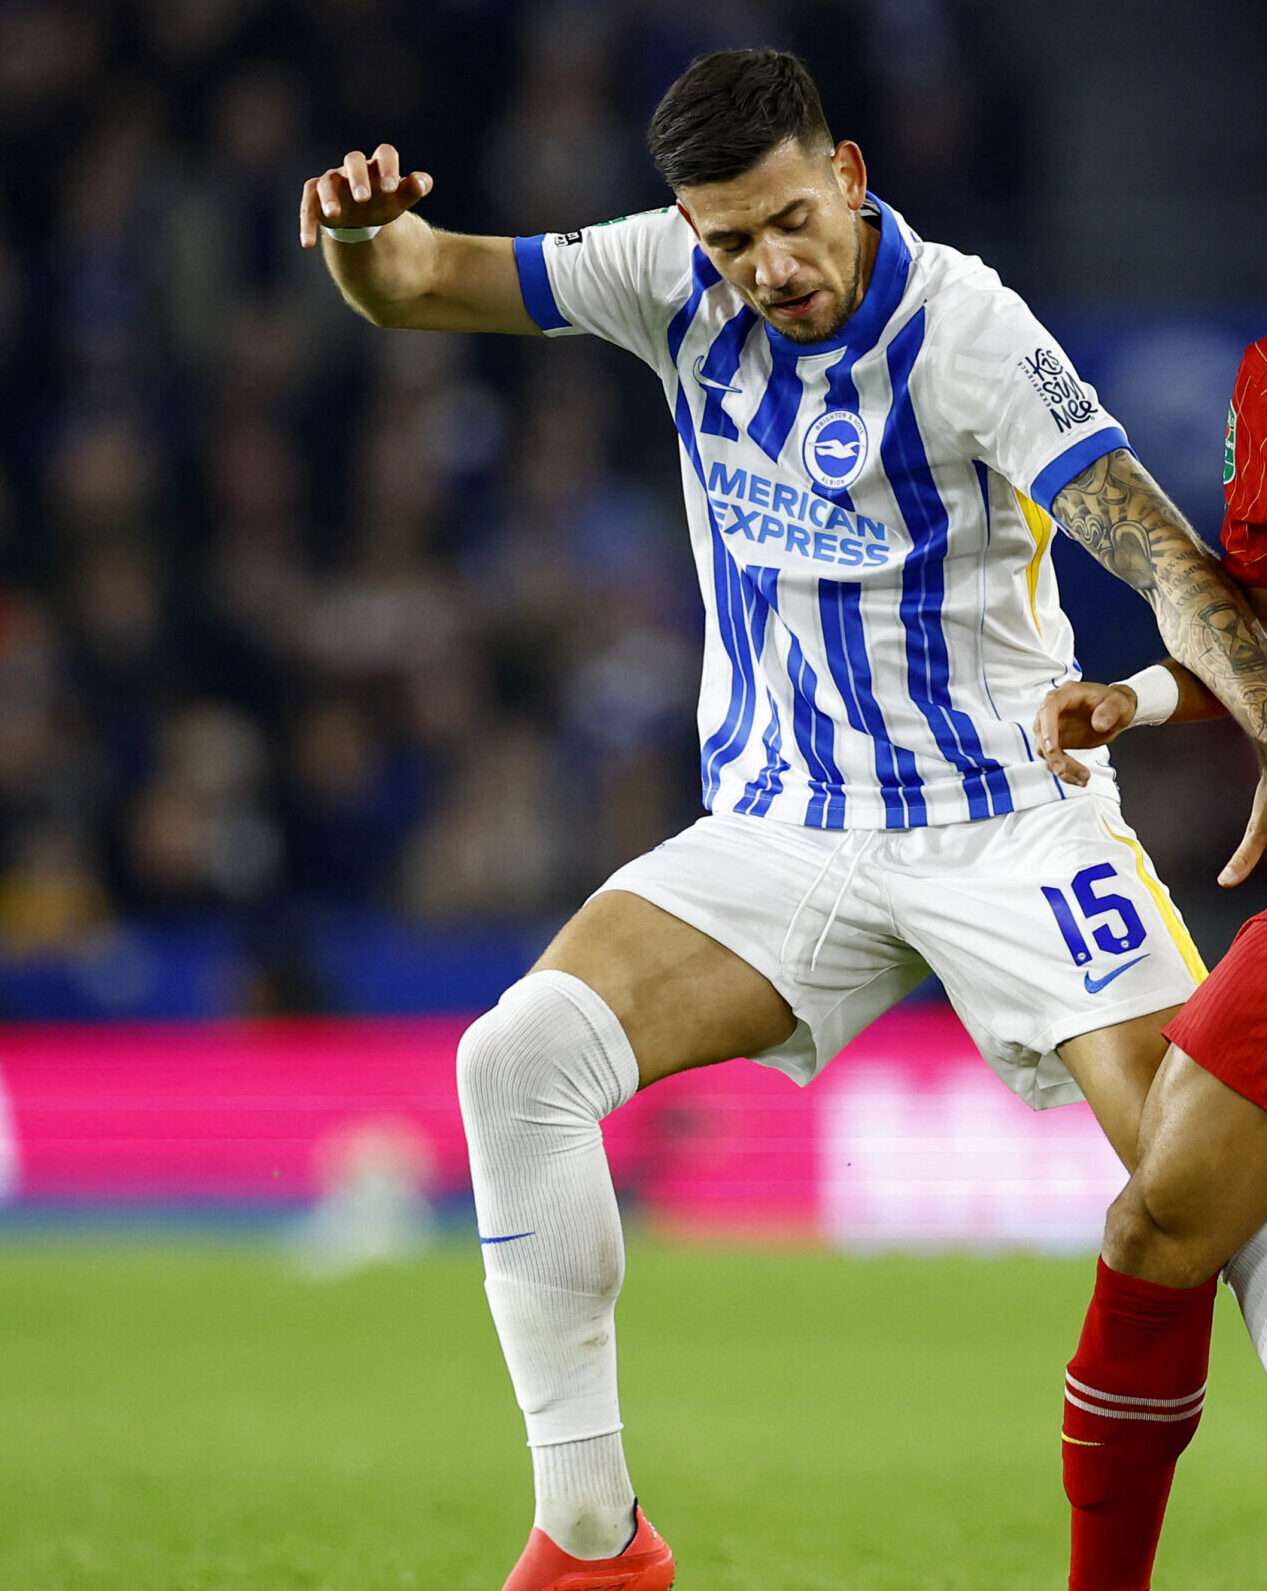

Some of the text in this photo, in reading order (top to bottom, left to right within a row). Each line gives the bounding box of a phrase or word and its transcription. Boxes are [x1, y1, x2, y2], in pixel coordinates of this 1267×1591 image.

[815, 412, 847, 431] BRIGHTON
[708, 461, 887, 541] MERICAN
[821, 477, 845, 486] ALBION
[711, 499, 891, 567] EXPRESS
[1040, 861, 1147, 967] 15
